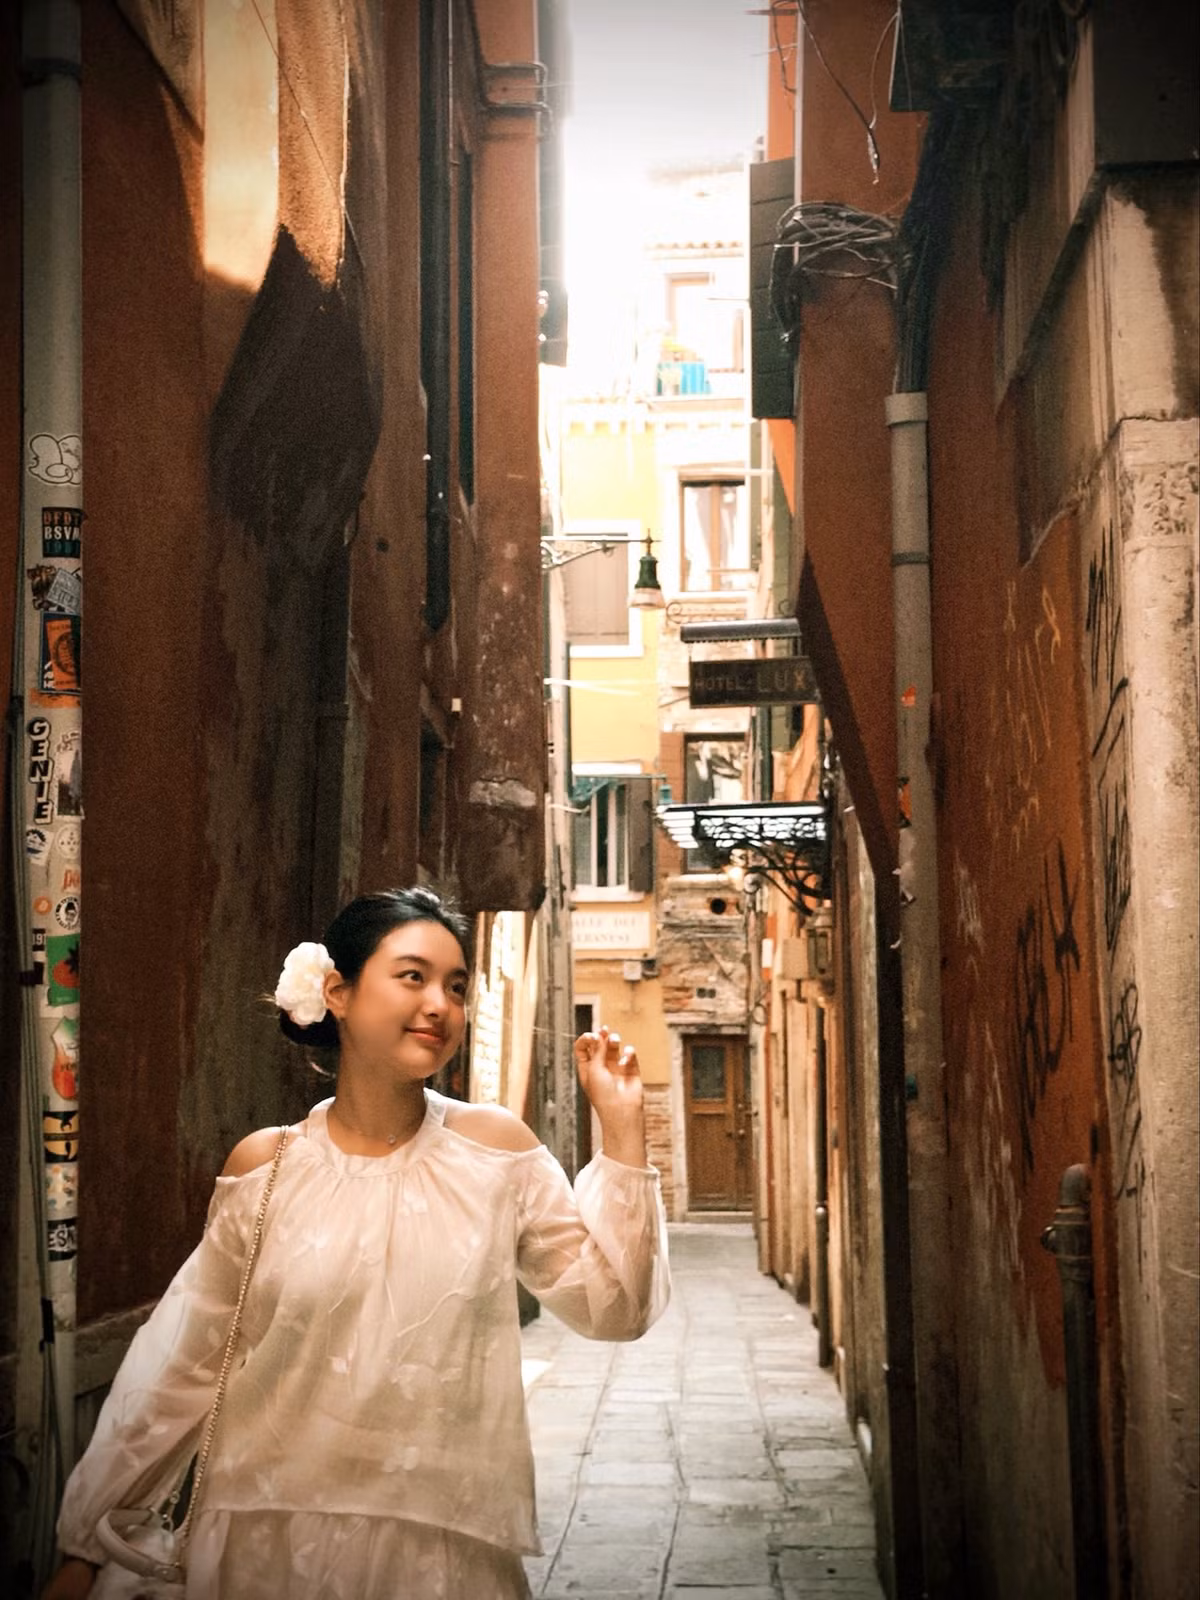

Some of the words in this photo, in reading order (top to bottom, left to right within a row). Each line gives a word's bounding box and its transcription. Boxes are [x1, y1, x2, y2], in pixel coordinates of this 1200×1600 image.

[695, 676, 743, 691] HOTEL
[757, 670, 806, 693] LUX
[27, 717, 54, 825] GENIE
